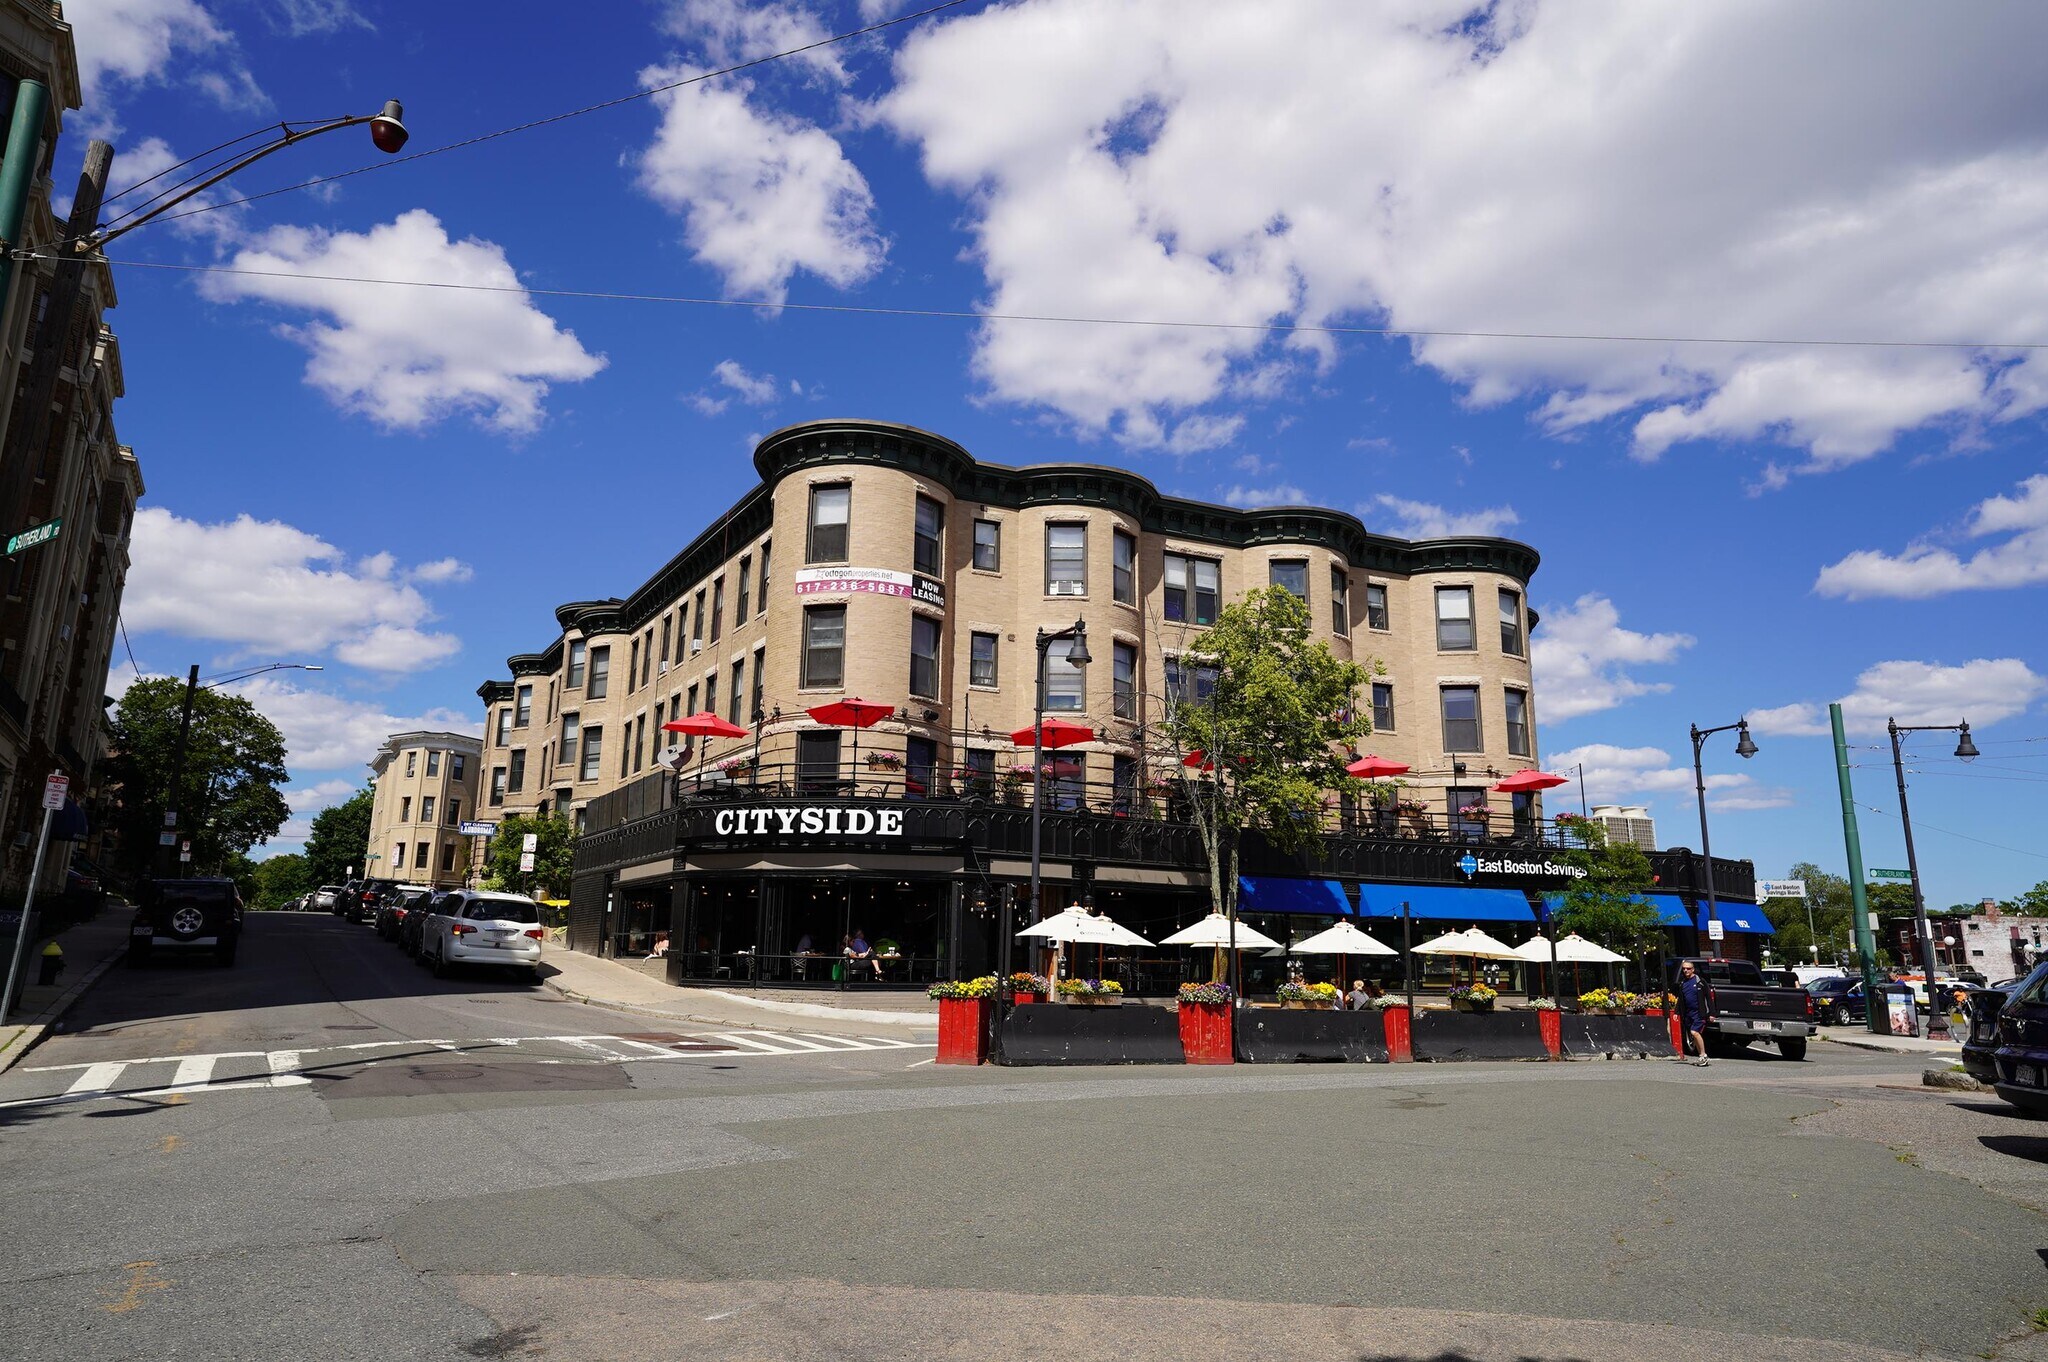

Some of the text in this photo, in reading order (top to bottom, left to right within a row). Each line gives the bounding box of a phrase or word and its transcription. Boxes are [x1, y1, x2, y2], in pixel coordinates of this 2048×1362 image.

[15, 524, 52, 550] SUTHERLAND
[797, 581, 905, 595] 617-236-5687
[921, 580, 940, 594] NOW
[912, 589, 945, 606] LEASING
[715, 807, 903, 836] CITYSIDE
[460, 826, 495, 834] LAUNDROMAT
[1477, 858, 1502, 873] East
[1504, 860, 1543, 875] Boston
[1544, 861, 1588, 879] Savings
[1877, 870, 1905, 878] SUTHERLAND
